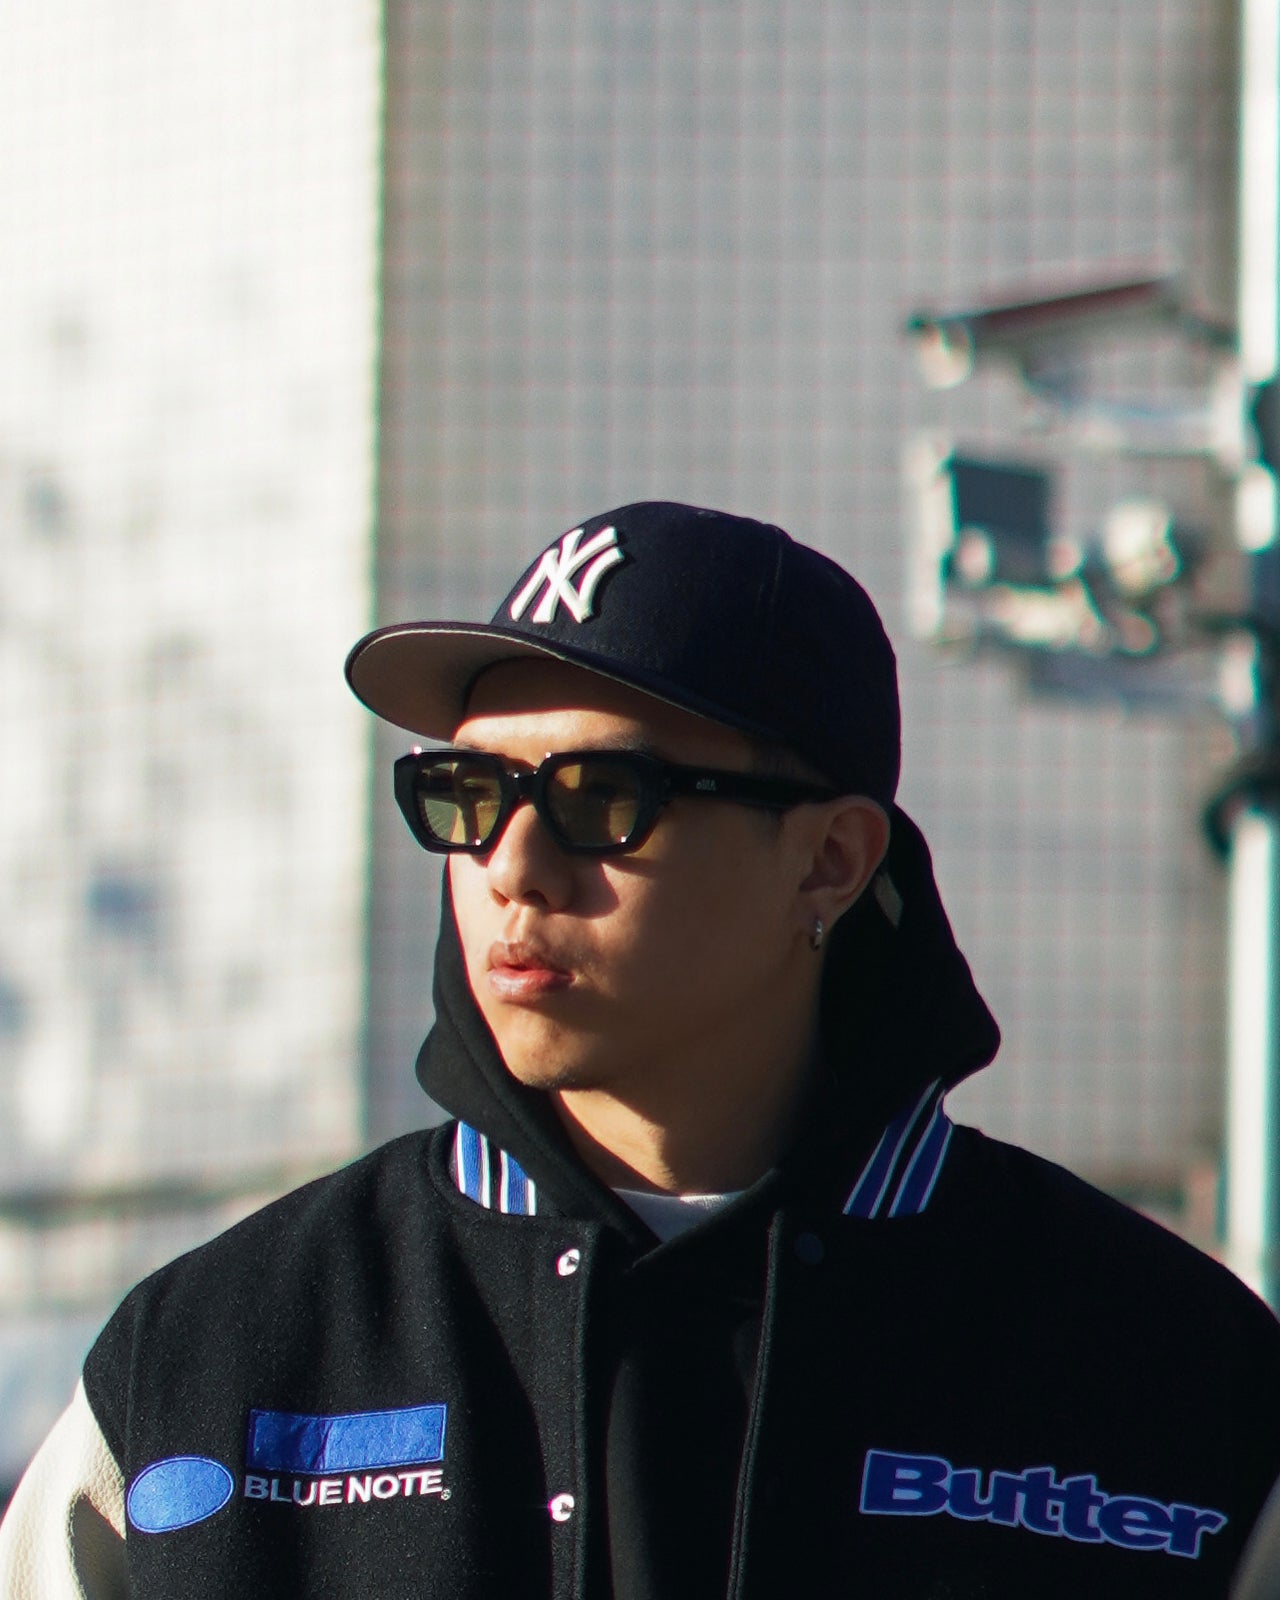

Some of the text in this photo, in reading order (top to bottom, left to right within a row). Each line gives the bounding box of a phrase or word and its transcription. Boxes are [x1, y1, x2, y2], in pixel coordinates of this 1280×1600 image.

[510, 526, 624, 624] NY
[244, 1469, 444, 1506] BLUE NOTE
[859, 1449, 1228, 1559] Butter
